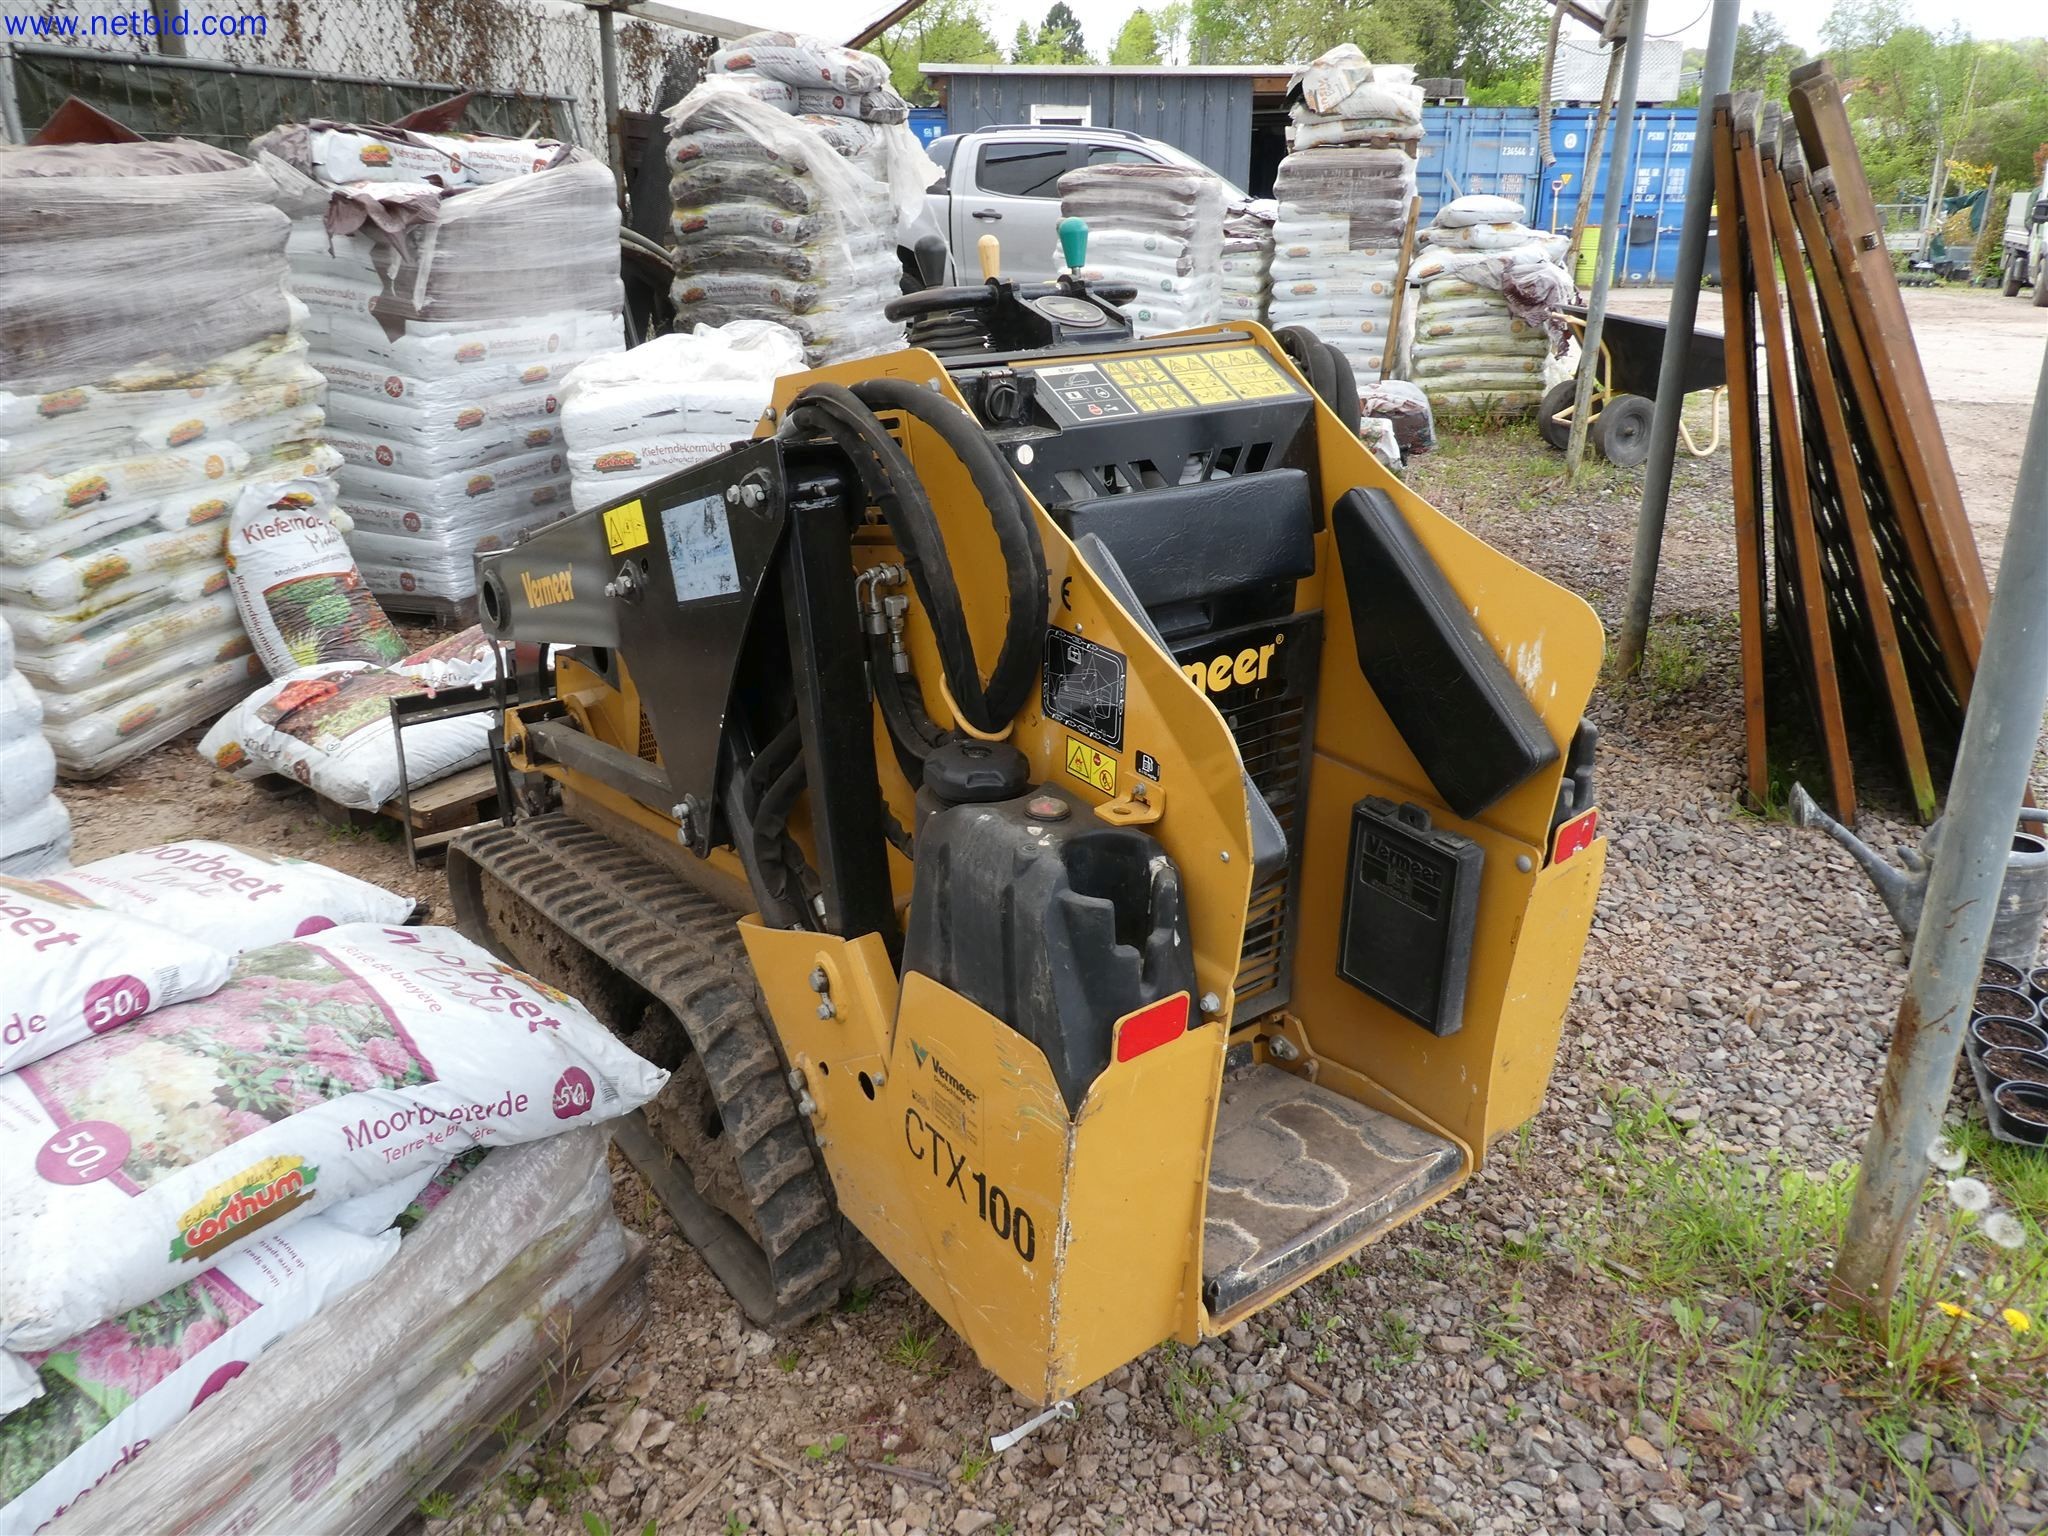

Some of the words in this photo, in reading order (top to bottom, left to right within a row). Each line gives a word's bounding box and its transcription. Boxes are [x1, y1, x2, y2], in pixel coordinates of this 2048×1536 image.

[520, 569, 575, 609] Vermeer
[932, 1056, 977, 1104] Vermeer
[50, 1131, 107, 1178] 50L
[382, 1139, 424, 1165] Terre
